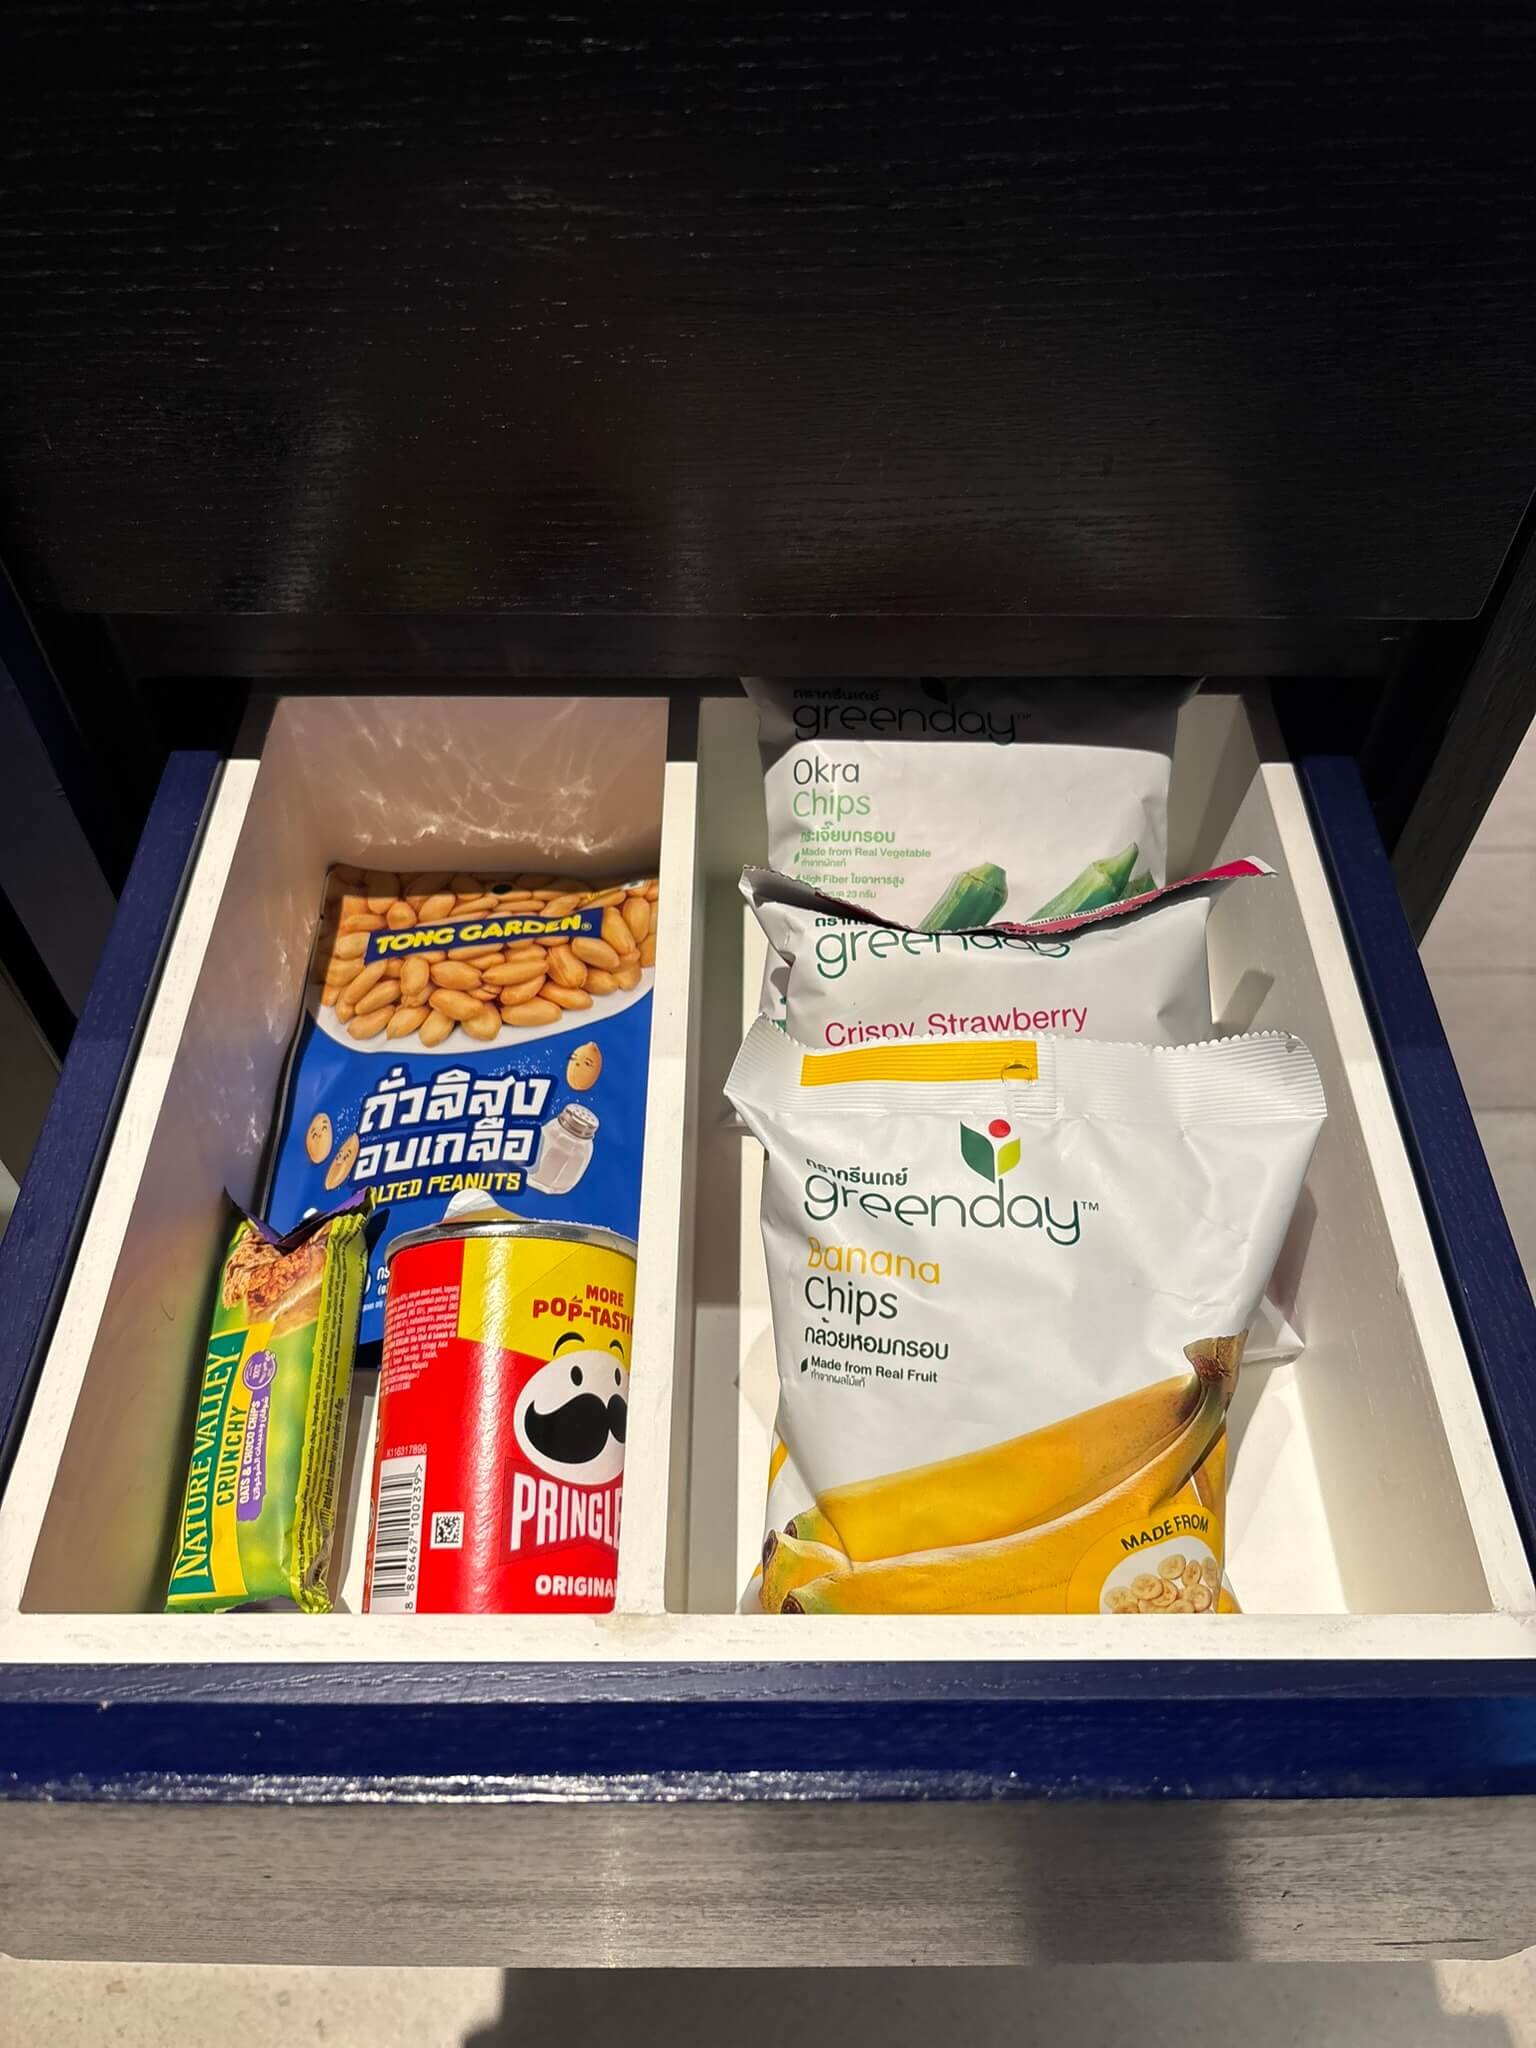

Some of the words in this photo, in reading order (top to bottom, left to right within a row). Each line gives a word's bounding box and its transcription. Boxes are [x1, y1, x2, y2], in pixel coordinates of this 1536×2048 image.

[792, 703, 1016, 745] greenday
[793, 755, 860, 786] Okra
[793, 787, 871, 822] Chips
[801, 847, 826, 858] Made
[828, 846, 852, 858] from
[854, 847, 878, 858] Real
[879, 848, 932, 860] Vegetable
[823, 874, 848, 884] Fiber
[376, 927, 456, 954] TONG
[459, 914, 582, 941] GARDEN
[927, 1007, 1088, 1037] Strawberry
[359, 1066, 551, 1134] ถั่วลิสง
[354, 1116, 534, 1181] อบเกลือ
[427, 1172, 521, 1195] PEANUTS
[803, 1173, 1081, 1246] greenday
[806, 1236, 940, 1285] Banana
[586, 1284, 624, 1308] MORE
[804, 1275, 899, 1325] Chips
[805, 1317, 949, 1360] กล้วยหอมกรอบ
[811, 1355, 842, 1372] Made
[844, 1360, 872, 1376] from
[875, 1365, 904, 1380] Real
[907, 1368, 938, 1384] Fruit
[248, 1400, 260, 1430] CHIPS
[174, 1456, 212, 1578] NATURE
[194, 1352, 241, 1456] VALLEY
[216, 1406, 247, 1506] CRUNCHY
[244, 1430, 256, 1465] CHOCO
[242, 1466, 251, 1477] &
[240, 1477, 250, 1505] OATS
[411, 1477, 423, 1527] 100239
[1120, 1519, 1173, 1551] MADE
[1173, 1513, 1209, 1534] FROM
[406, 1539, 419, 1592] 886467
[535, 1574, 617, 1598] ORIGINA
